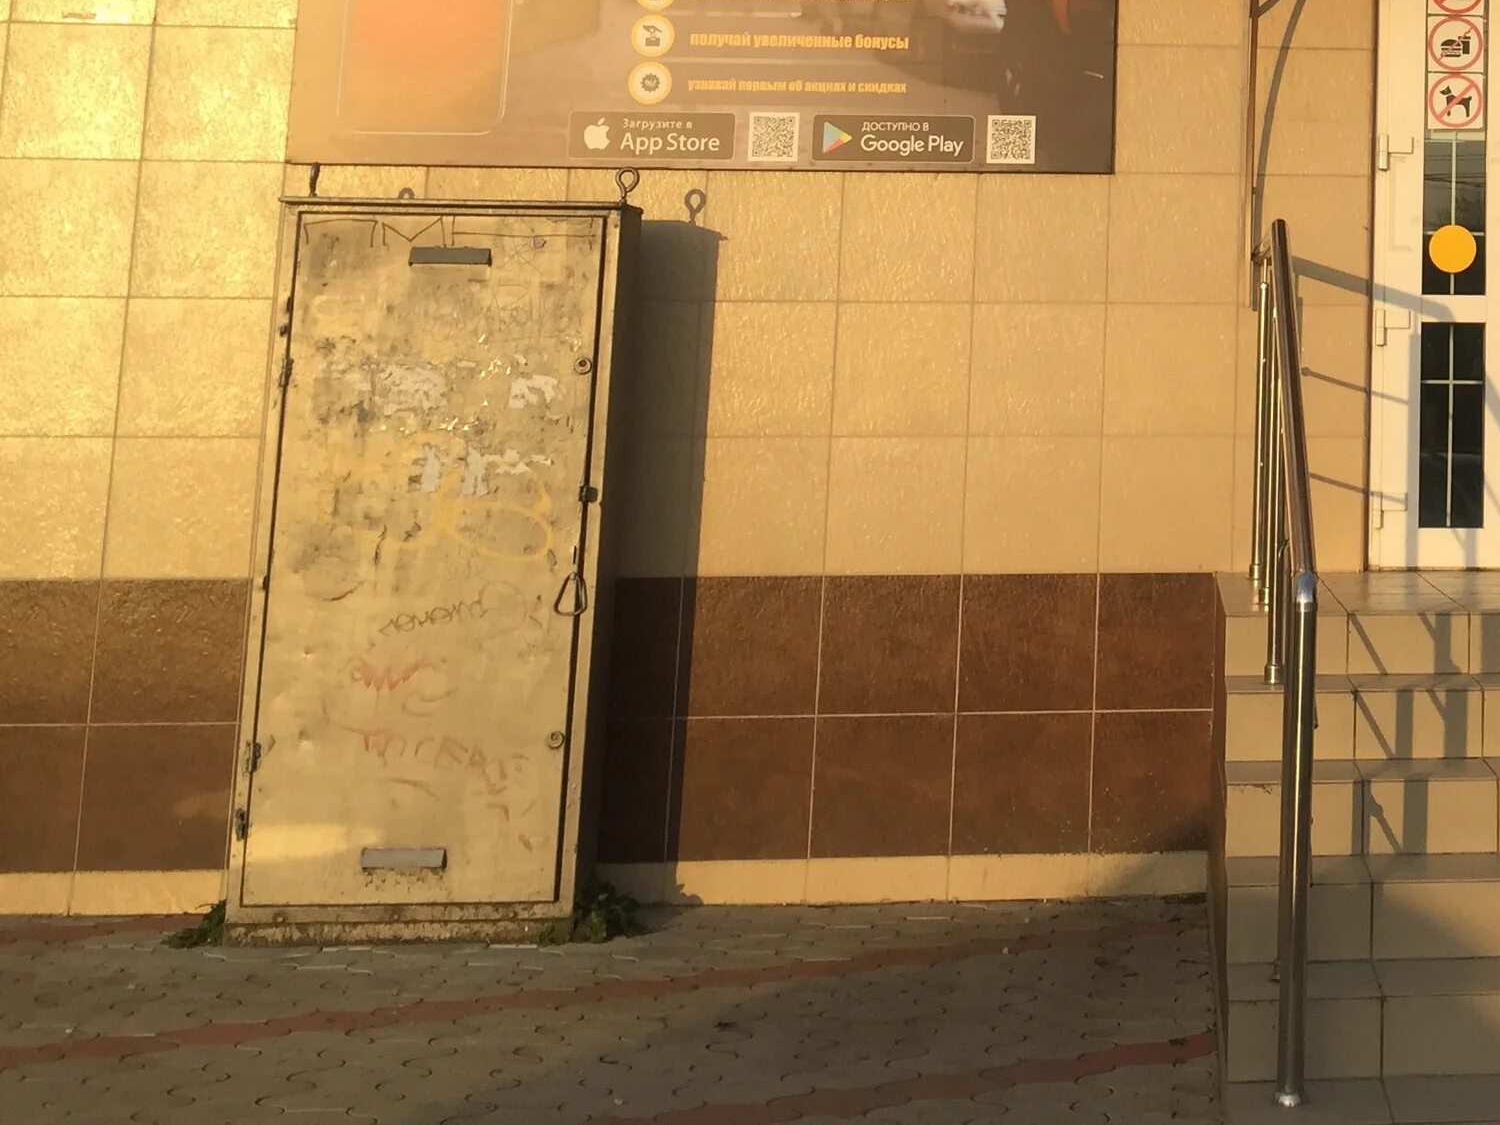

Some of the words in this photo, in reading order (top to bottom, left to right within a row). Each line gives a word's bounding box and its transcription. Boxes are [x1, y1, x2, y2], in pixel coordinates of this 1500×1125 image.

[690, 31, 751, 48] получай
[753, 33, 853, 49] увеличенные
[854, 33, 910, 50] бонусы
[688, 77, 737, 91] узнавай
[738, 79, 787, 92] первым
[788, 79, 803, 92] об
[804, 81, 846, 94] акциях
[847, 82, 856, 93] и
[857, 81, 907, 94] скидках
[622, 117, 683, 132] Загрузите
[685, 120, 693, 130] в
[861, 121, 921, 133] ДОСТУПНО
[923, 122, 930, 133] В
[619, 132, 663, 155] App
[667, 133, 720, 152] Store
[860, 135, 924, 156] Google
[927, 136, 964, 158] Play
